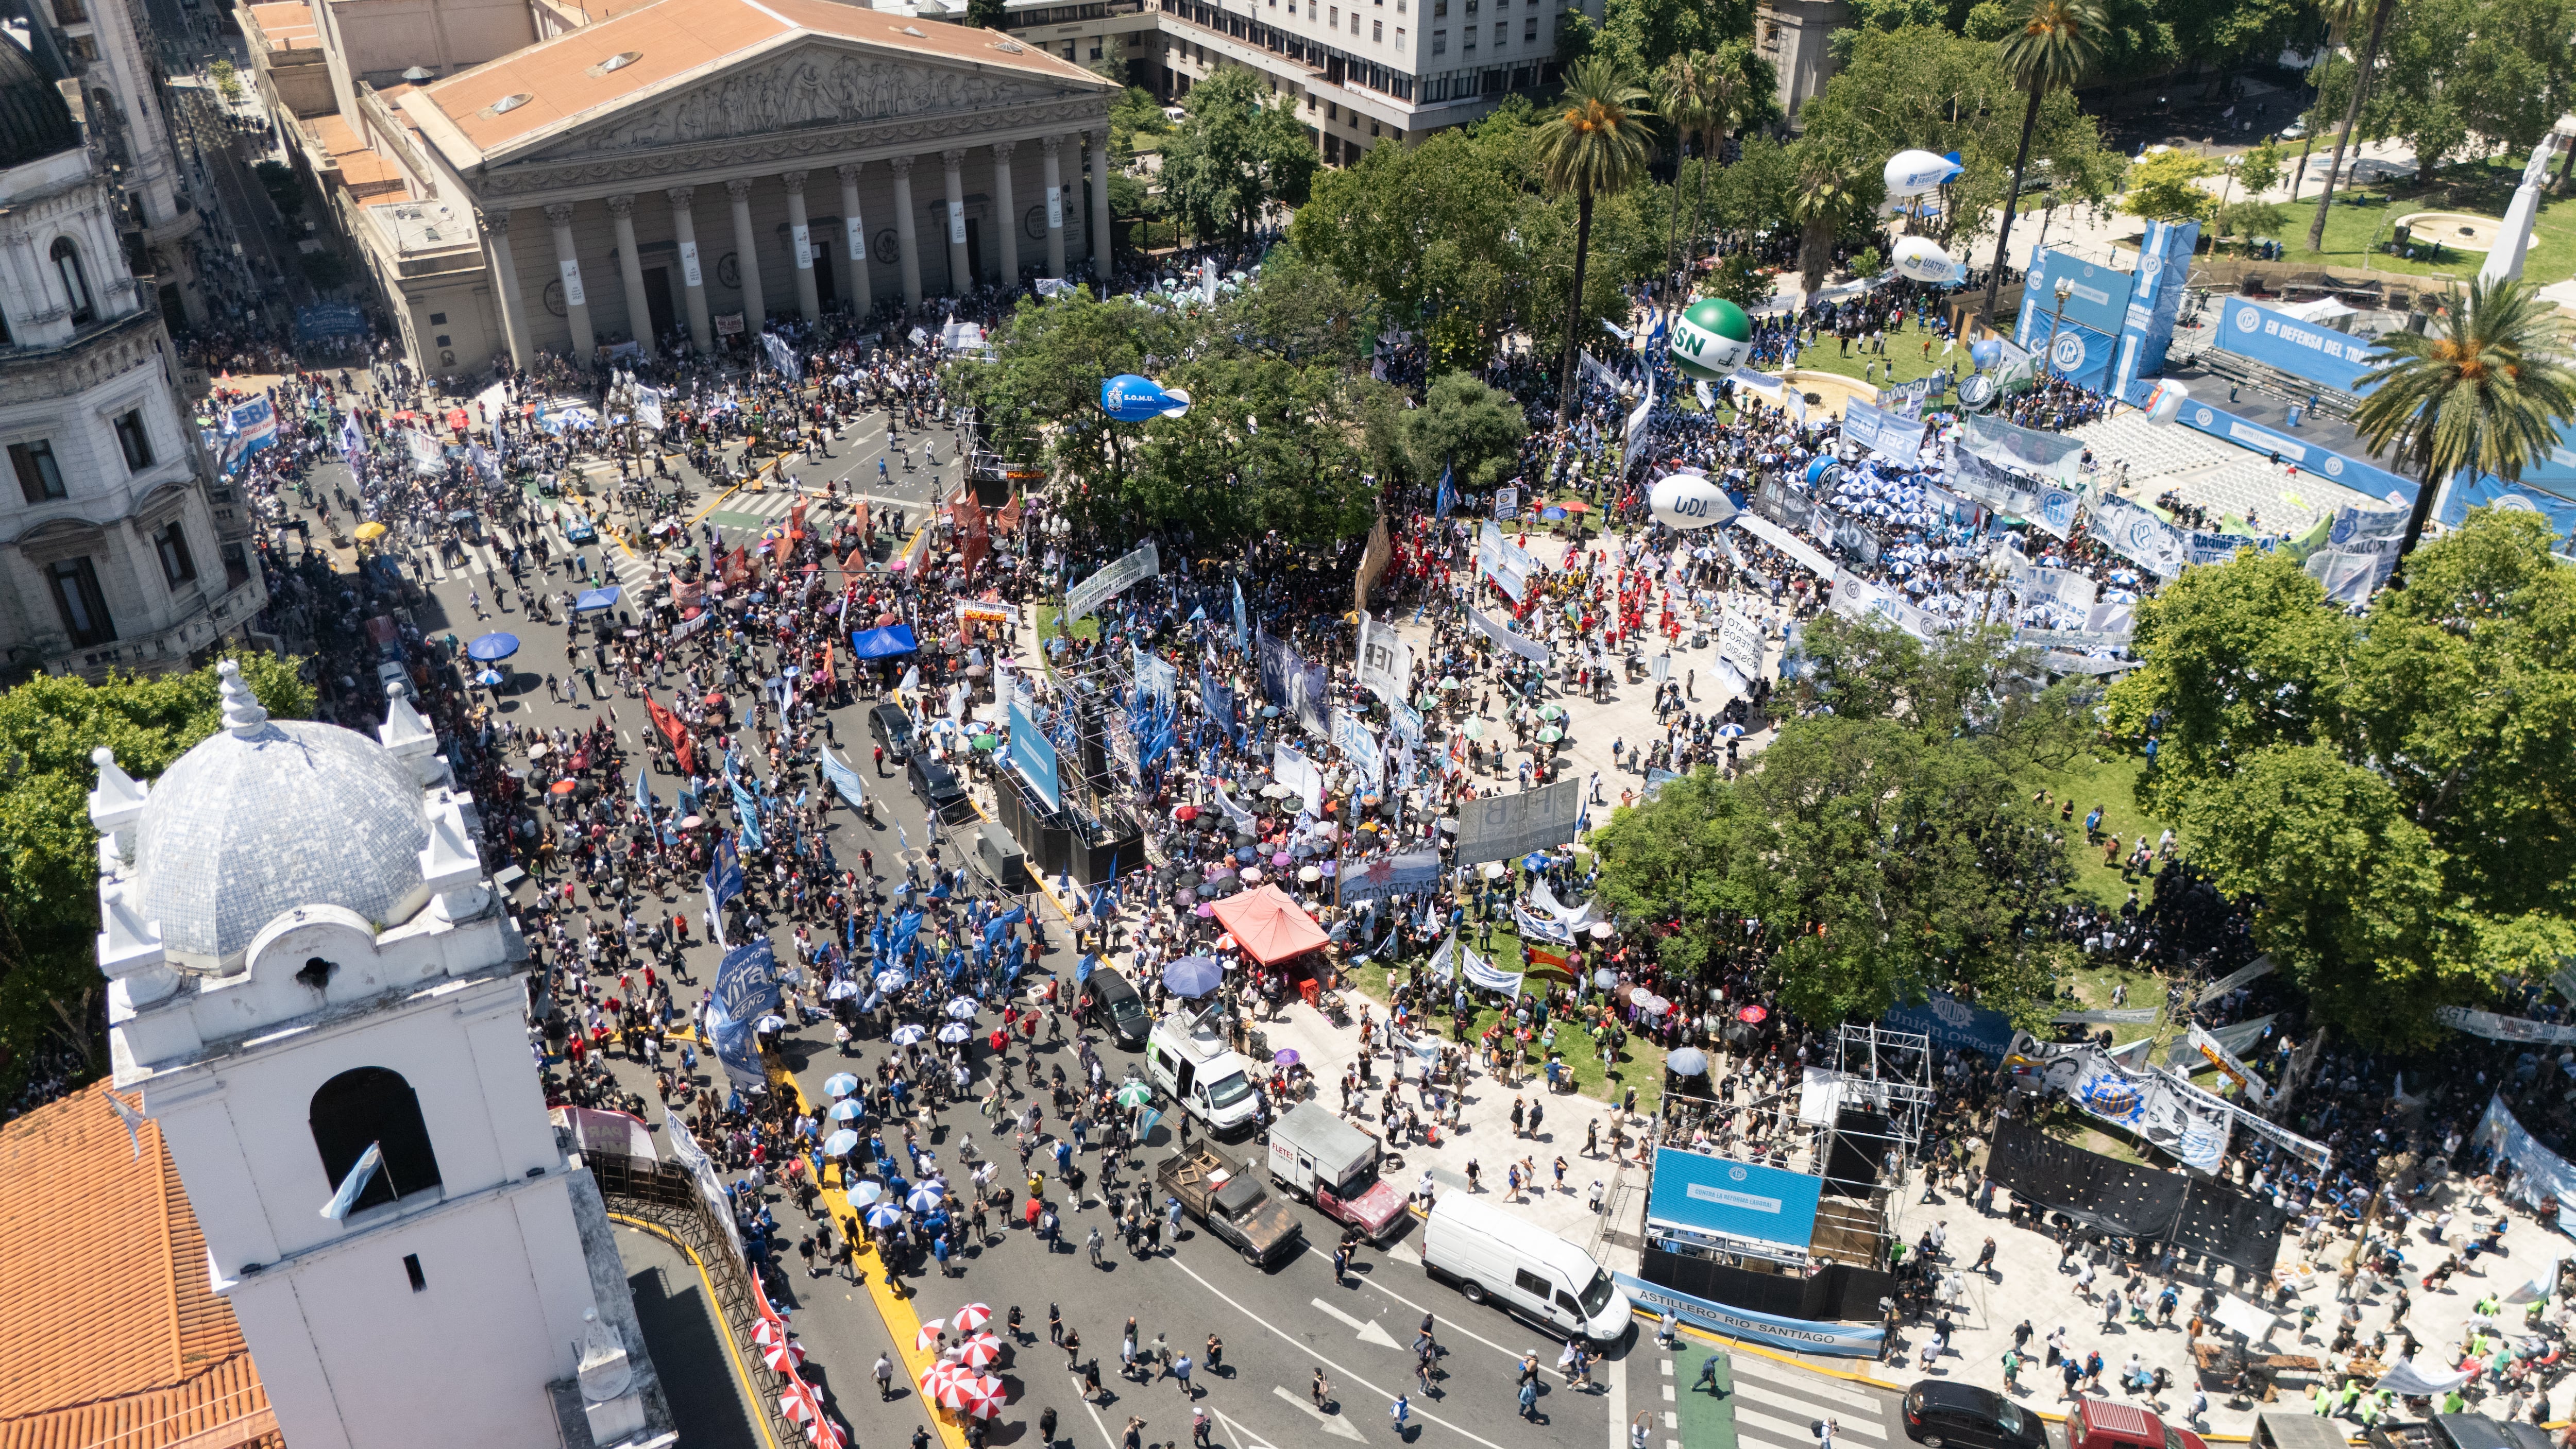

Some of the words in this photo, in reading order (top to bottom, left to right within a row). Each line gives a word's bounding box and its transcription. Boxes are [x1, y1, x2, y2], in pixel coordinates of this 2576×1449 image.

[1917, 174, 1941, 184] SEGURO
[1923, 258, 1946, 273] UATRE
[2265, 319, 2279, 335] EN
[2279, 325, 2323, 351] DEFENSA
[2324, 339, 2342, 357] DEL
[1496, 508, 1514, 518] MOSER
[1674, 496, 1707, 518] UDA
[1089, 584, 1112, 604] REFORMA
[965, 611, 980, 619] PCR
[991, 612, 1006, 622] JCR
[974, 602, 996, 611] REFORMA
[1887, 1009, 1942, 1038] Unión
[1948, 1031, 2006, 1055] Obrera
[1273, 1142, 1293, 1161] FLETES
[1695, 1188, 1716, 1197] CONTRA
[1724, 1194, 1748, 1204] REFORMA
[1749, 1199, 1772, 1208] LABORAL
[1640, 1291, 1717, 1319] ASTILLERO
[1725, 1316, 1750, 1328] RIO
[1758, 1323, 1834, 1344] SANTIAGO
